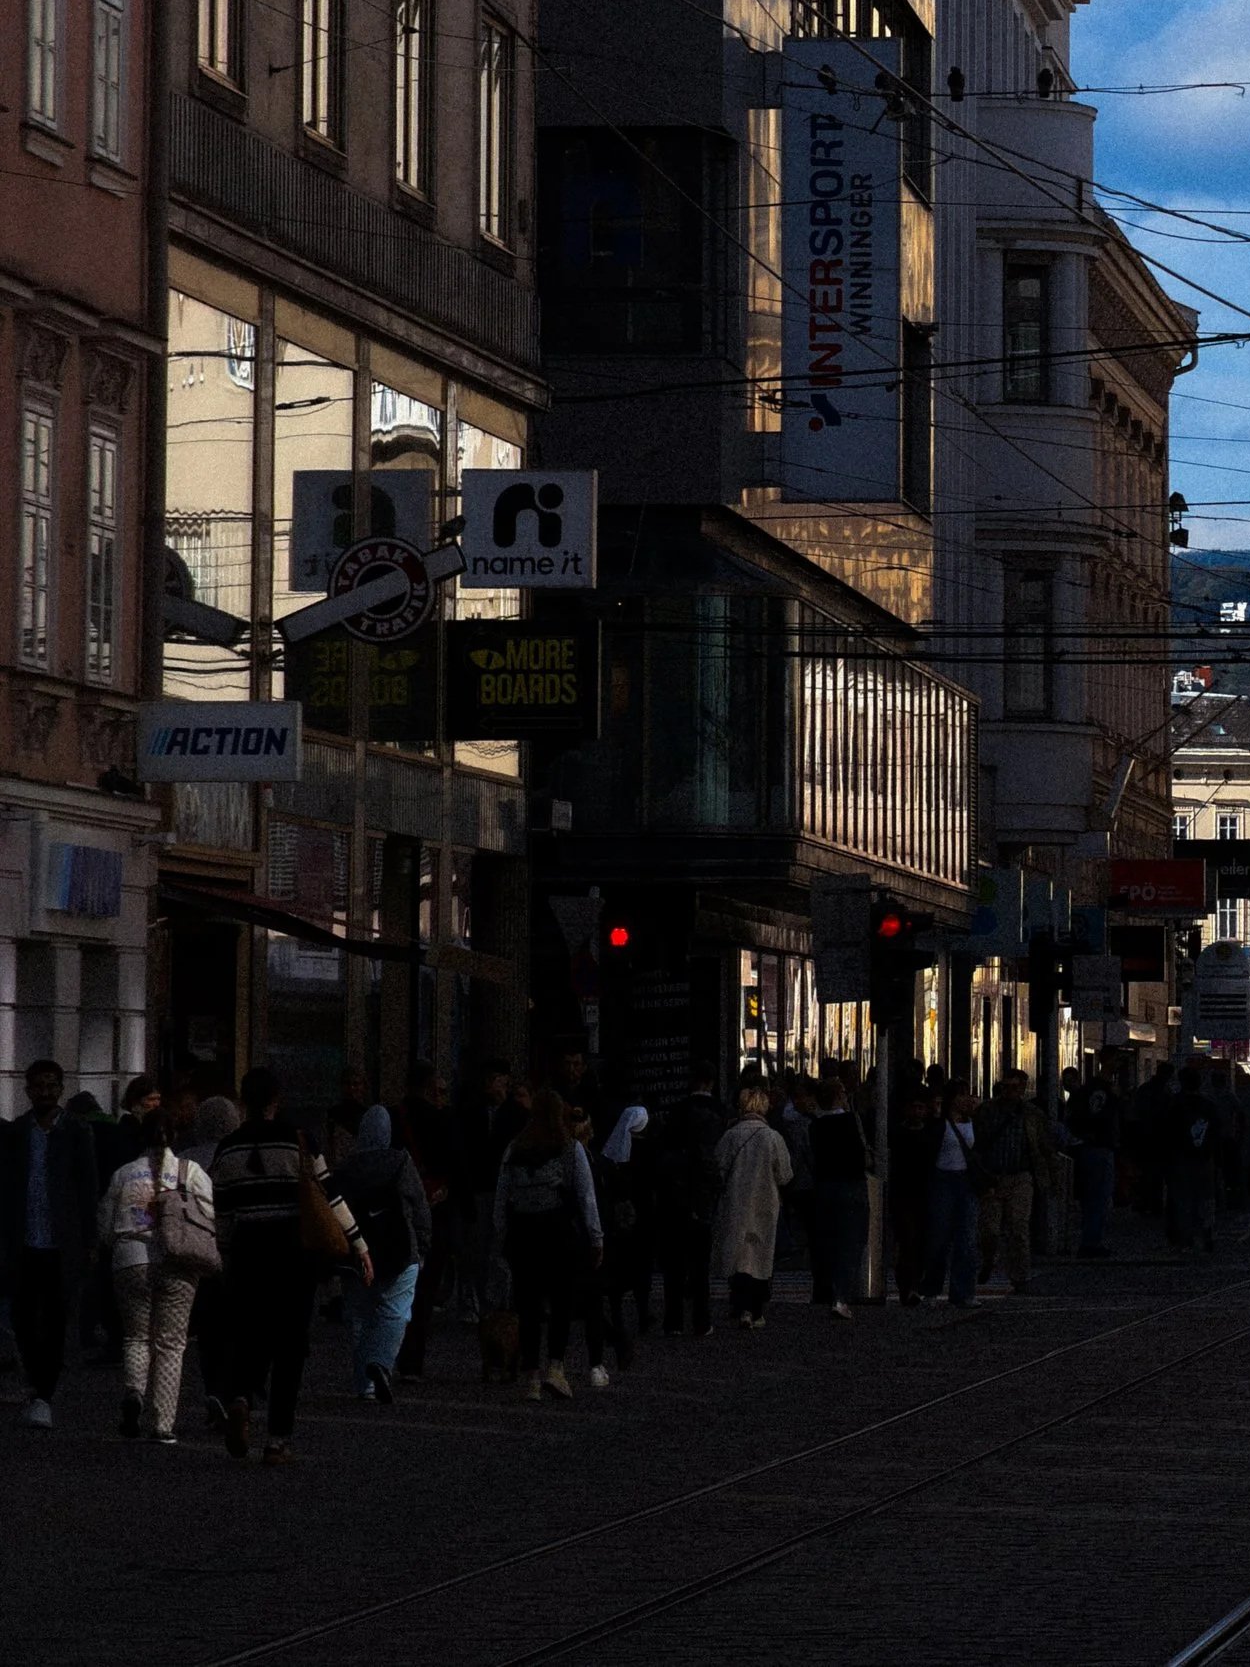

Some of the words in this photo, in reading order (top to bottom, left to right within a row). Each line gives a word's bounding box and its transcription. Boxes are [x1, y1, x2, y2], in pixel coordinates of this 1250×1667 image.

[809, 114, 845, 386] INTERSPORT
[850, 172, 874, 337] WINNINGER
[337, 544, 409, 587] TABAK
[471, 554, 556, 576] name
[562, 551, 583, 576] it
[359, 581, 427, 635] TRAFIK
[505, 638, 575, 673] MORE
[479, 673, 579, 707] BOARDS
[165, 726, 289, 757] ACTION
